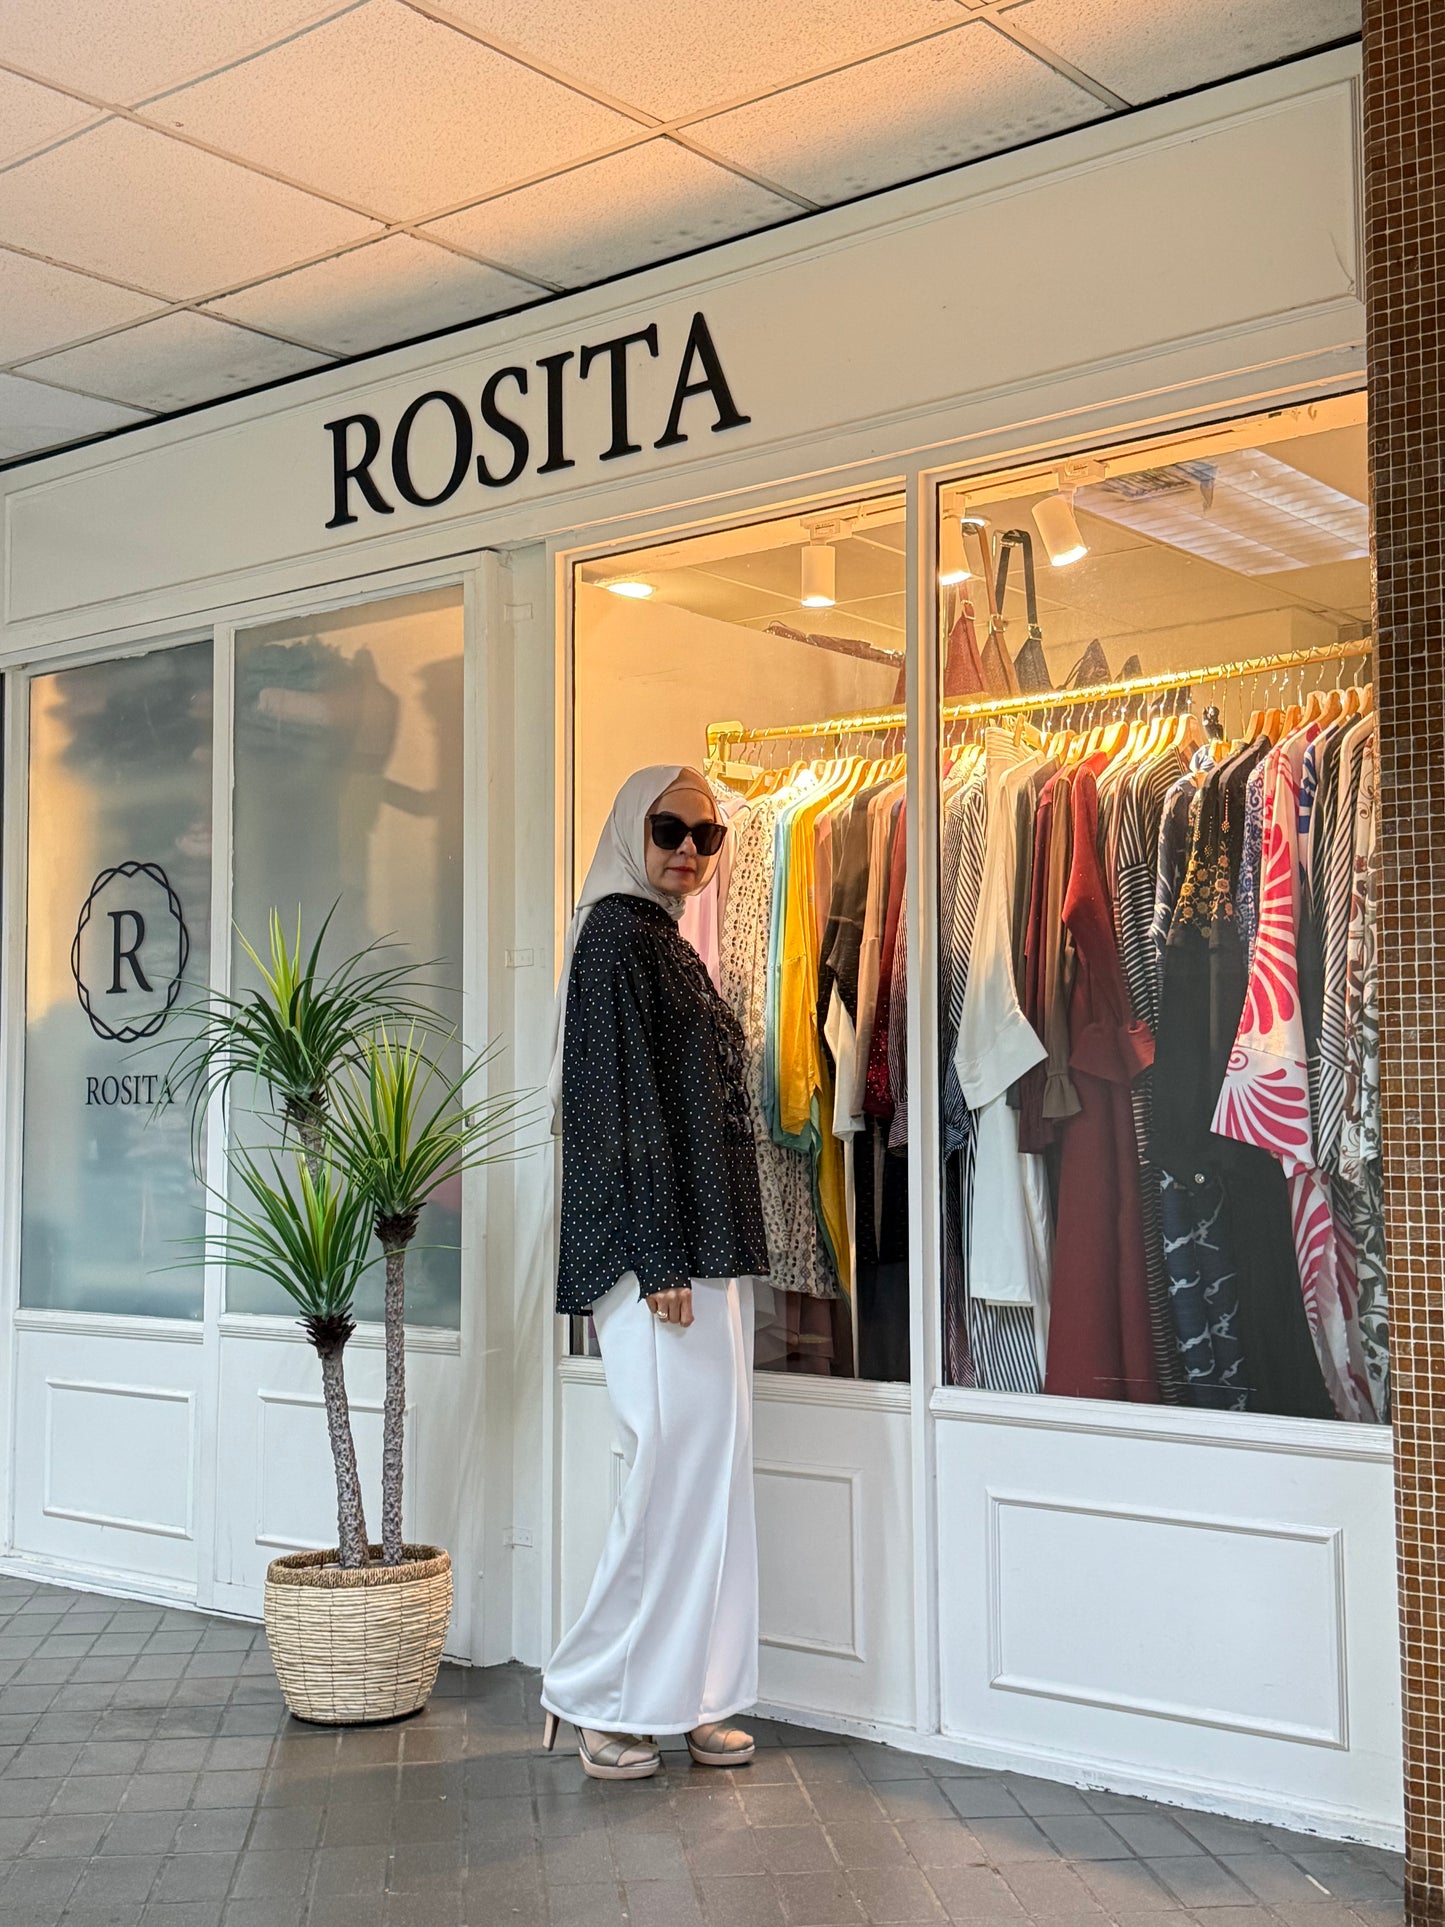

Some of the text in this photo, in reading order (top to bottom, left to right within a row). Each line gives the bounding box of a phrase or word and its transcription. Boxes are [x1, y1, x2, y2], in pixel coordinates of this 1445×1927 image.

[323, 311, 751, 529] ROSITA
[105, 909, 154, 994] R
[85, 1074, 175, 1106] ROSITA
